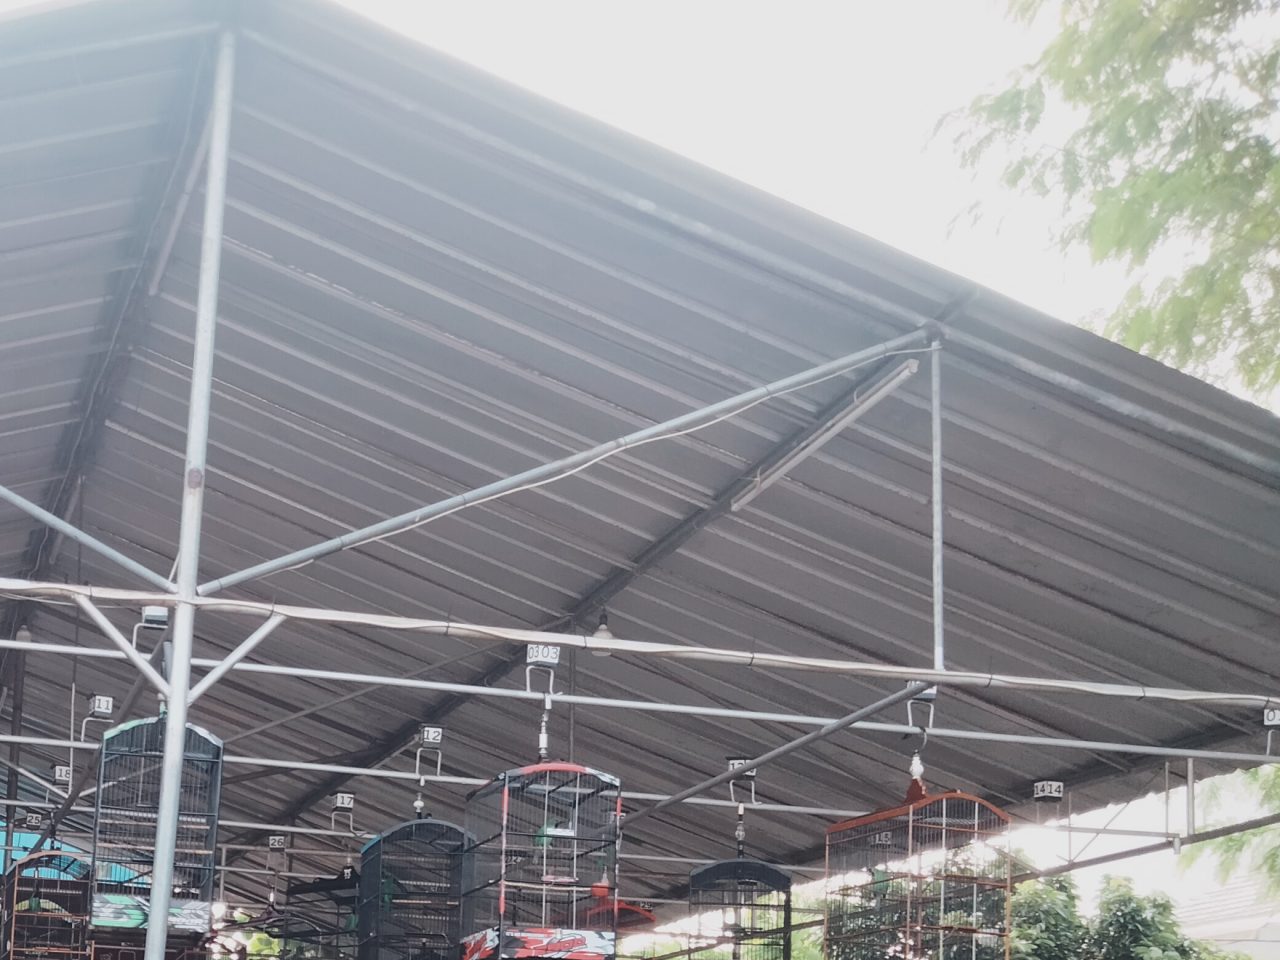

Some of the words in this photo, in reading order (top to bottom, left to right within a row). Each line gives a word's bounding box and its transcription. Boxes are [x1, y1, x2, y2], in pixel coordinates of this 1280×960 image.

[541, 646, 559, 660] 03
[96, 698, 111, 711] 11
[423, 730, 441, 741] 12
[57, 767, 71, 779] 18
[1047, 783, 1062, 795] 14
[339, 795, 354, 806] 17
[27, 815, 40, 825] 25
[270, 838, 284, 847] 26
